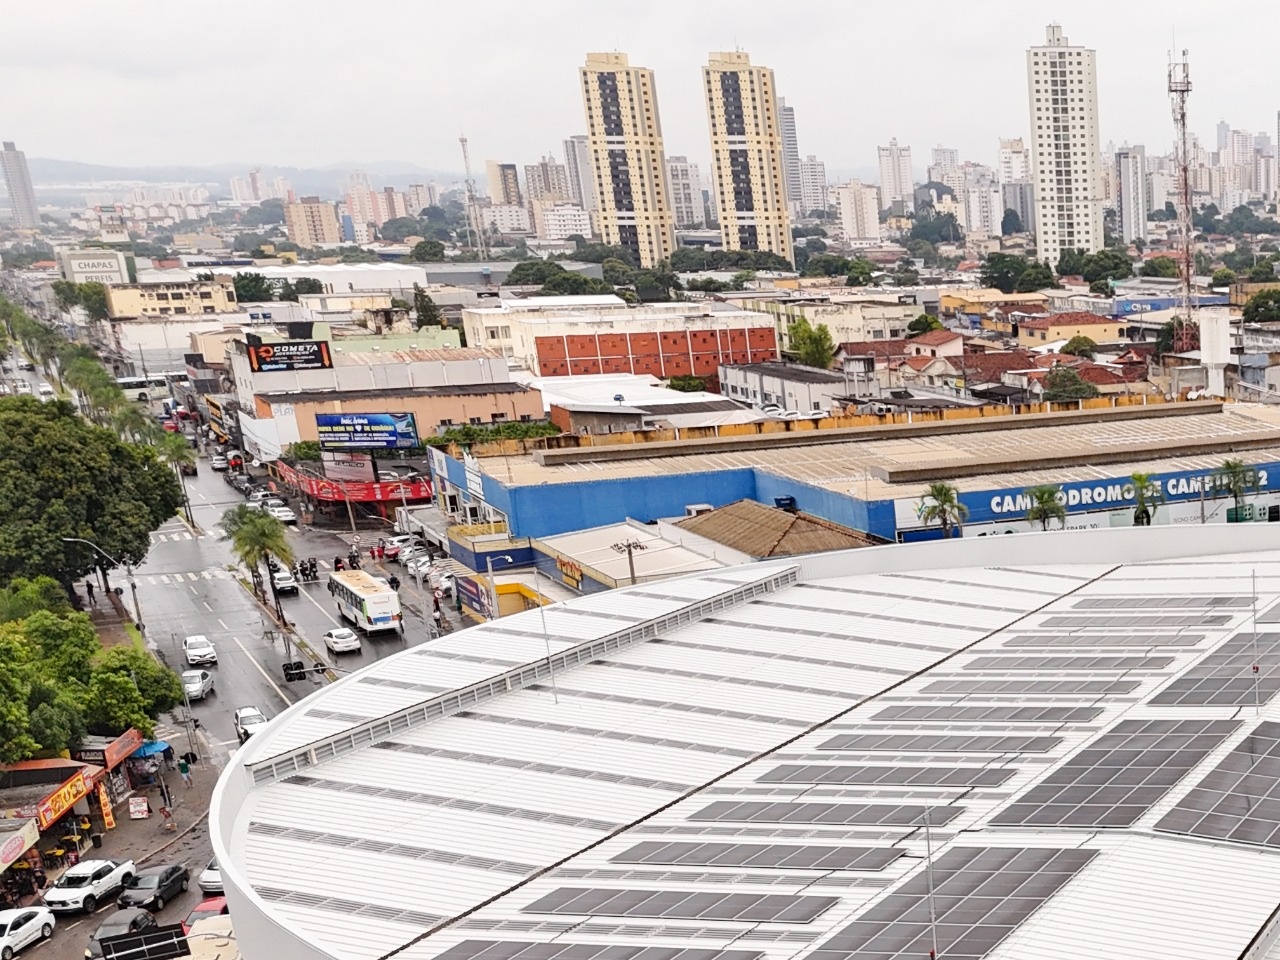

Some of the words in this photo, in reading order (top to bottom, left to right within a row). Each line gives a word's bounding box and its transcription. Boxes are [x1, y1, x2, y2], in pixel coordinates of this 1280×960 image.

[78, 261, 113, 270] CHAPAS
[991, 484, 1135, 513] CAMÓDROMO
[1258, 470, 1268, 486] 2
